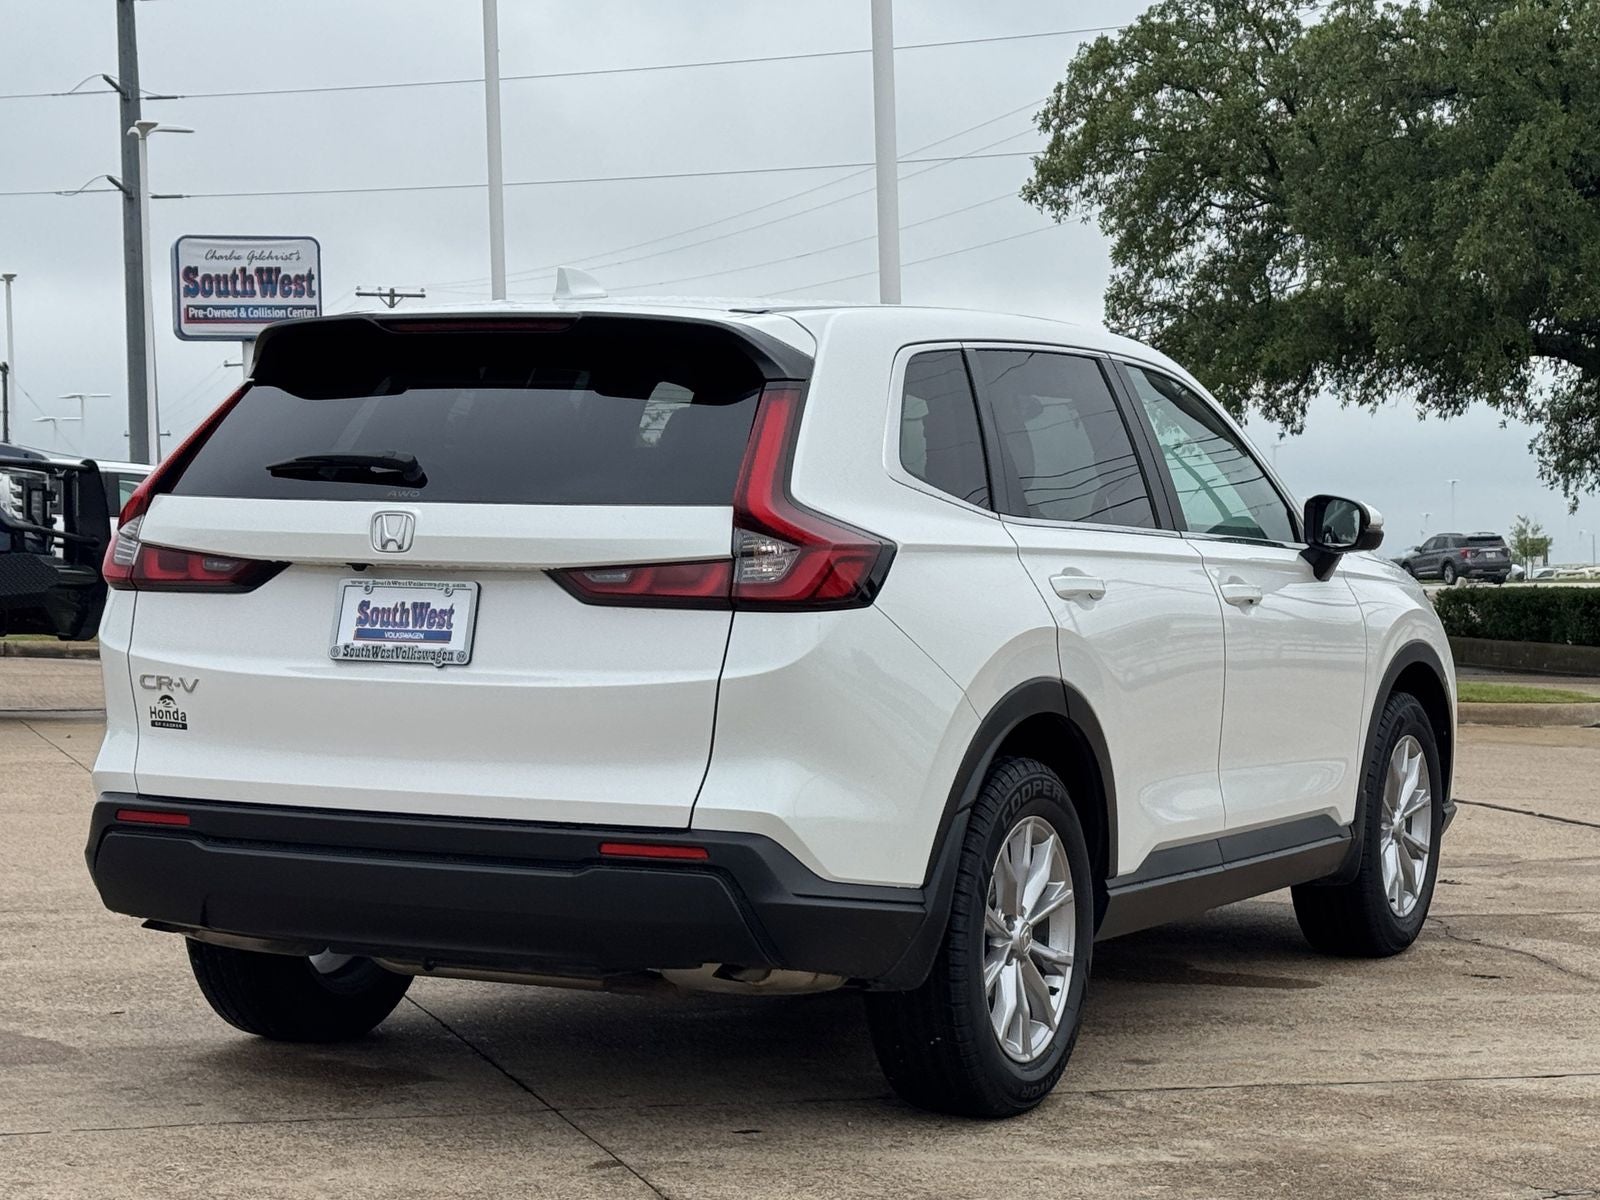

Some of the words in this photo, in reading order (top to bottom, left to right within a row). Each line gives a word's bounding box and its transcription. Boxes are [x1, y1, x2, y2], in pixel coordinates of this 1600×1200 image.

[205, 249, 243, 261] Charlie
[246, 249, 301, 265] Gilchrist's
[182, 265, 316, 298] SouthWest
[188, 306, 237, 318] Pre-Owned
[239, 307, 247, 318] &
[247, 307, 286, 318] Collision
[287, 307, 316, 318] Center
[356, 600, 455, 629] SouthWest
[384, 631, 425, 640] VOLKSWAGEN
[342, 644, 454, 664] SouthWestVolkswagen
[139, 674, 200, 693] CR-V
[149, 706, 187, 722] Honda
[1001, 780, 1061, 830] COOPER
